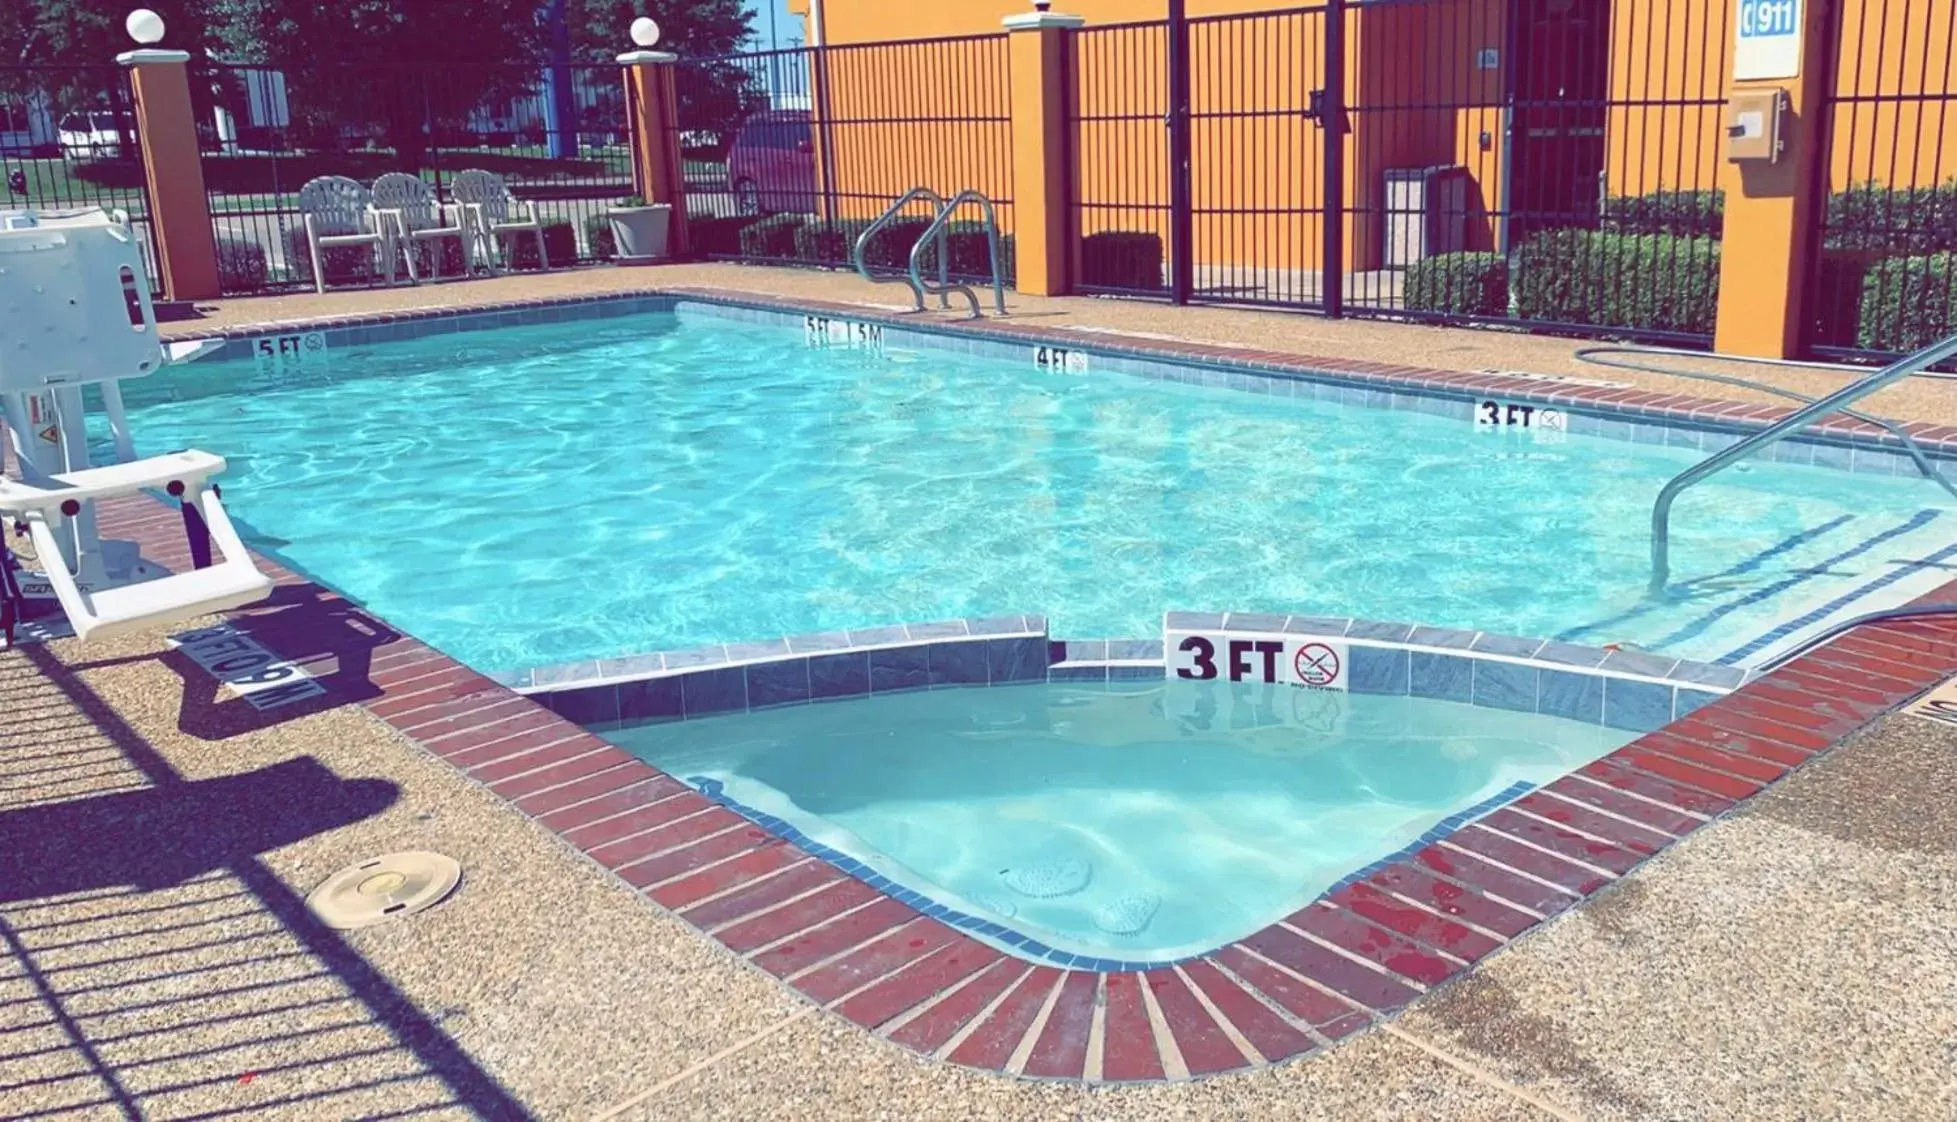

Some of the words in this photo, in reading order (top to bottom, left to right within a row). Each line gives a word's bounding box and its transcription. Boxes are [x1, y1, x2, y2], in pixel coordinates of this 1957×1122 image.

[1758, 1, 1792, 32] 911
[260, 339, 275, 356] 5
[279, 336, 301, 356] FT
[1037, 346, 1049, 365] 4
[1052, 348, 1068, 367] FT
[1480, 400, 1500, 425] 3
[1506, 404, 1535, 427] FT
[1176, 636, 1218, 681] 3
